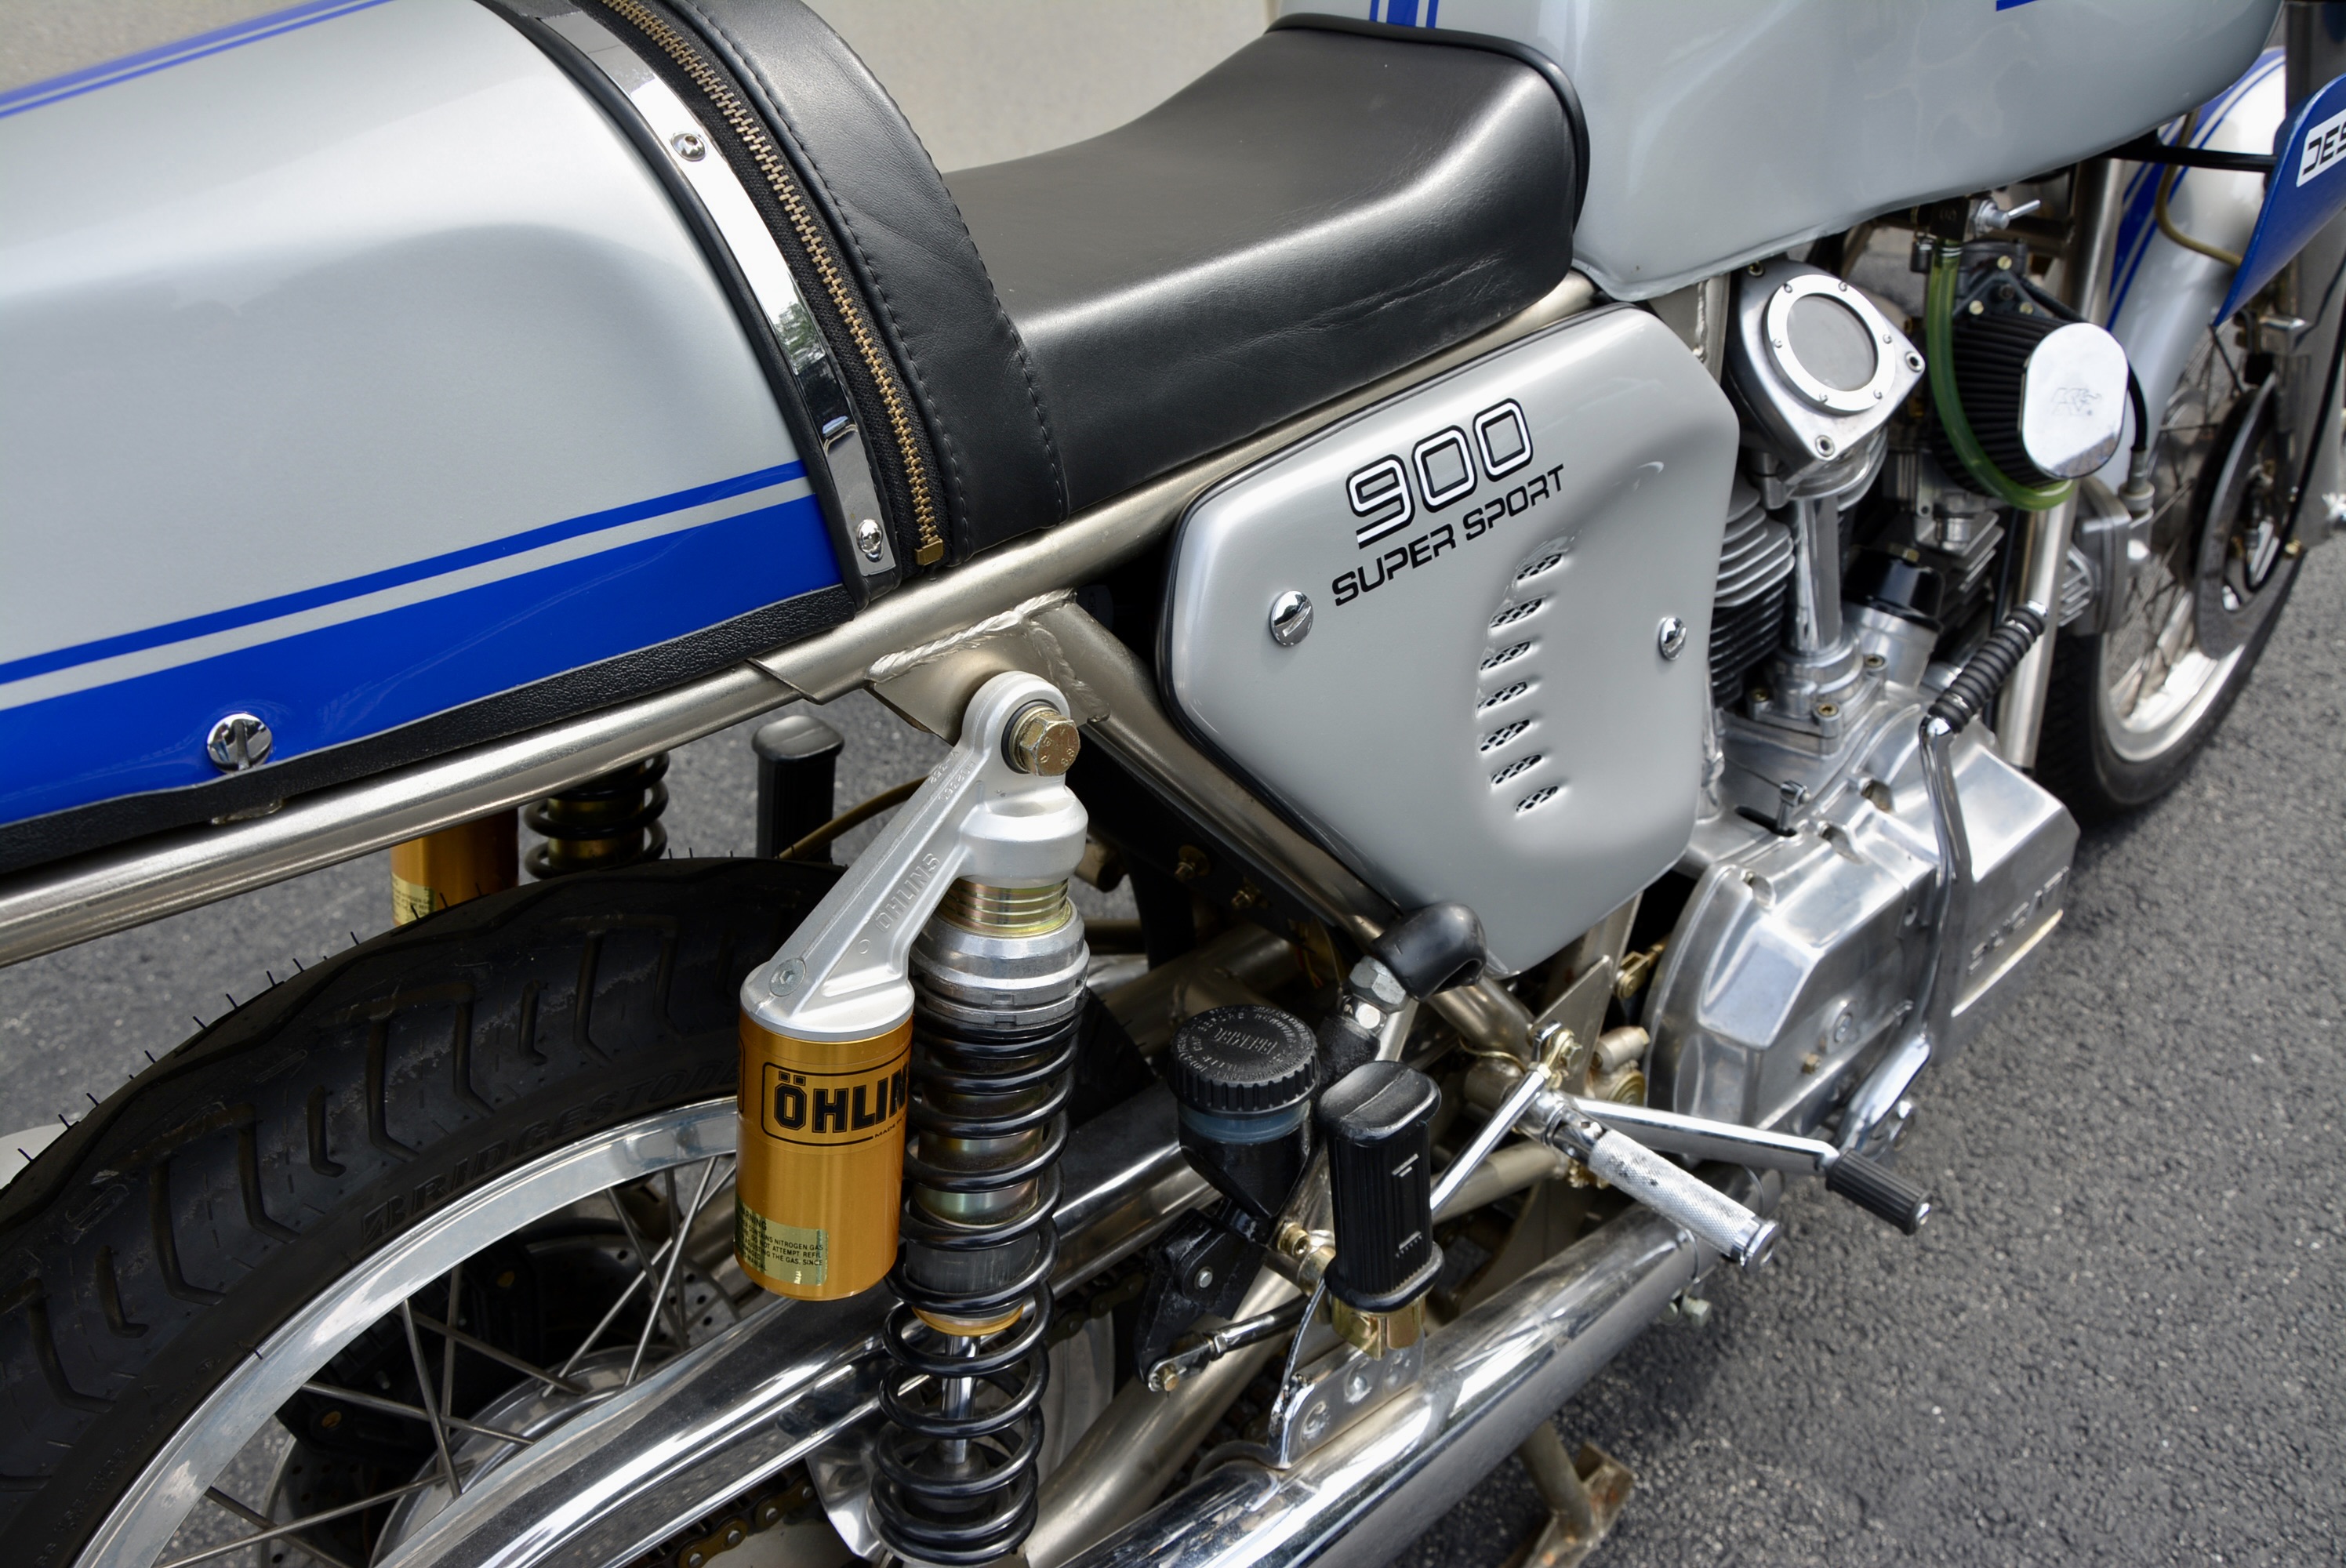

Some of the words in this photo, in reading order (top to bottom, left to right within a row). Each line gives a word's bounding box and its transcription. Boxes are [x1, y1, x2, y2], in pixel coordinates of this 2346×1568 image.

[1346, 397, 1534, 550] 900
[1331, 523, 1457, 607] SUPER
[1462, 463, 1564, 541] SPORT
[875, 853, 940, 933] ÖHLINS
[772, 1247, 800, 1257] ATTEMPT
[772, 1253, 783, 1261] THE
[774, 1239, 808, 1250] NITROGEN
